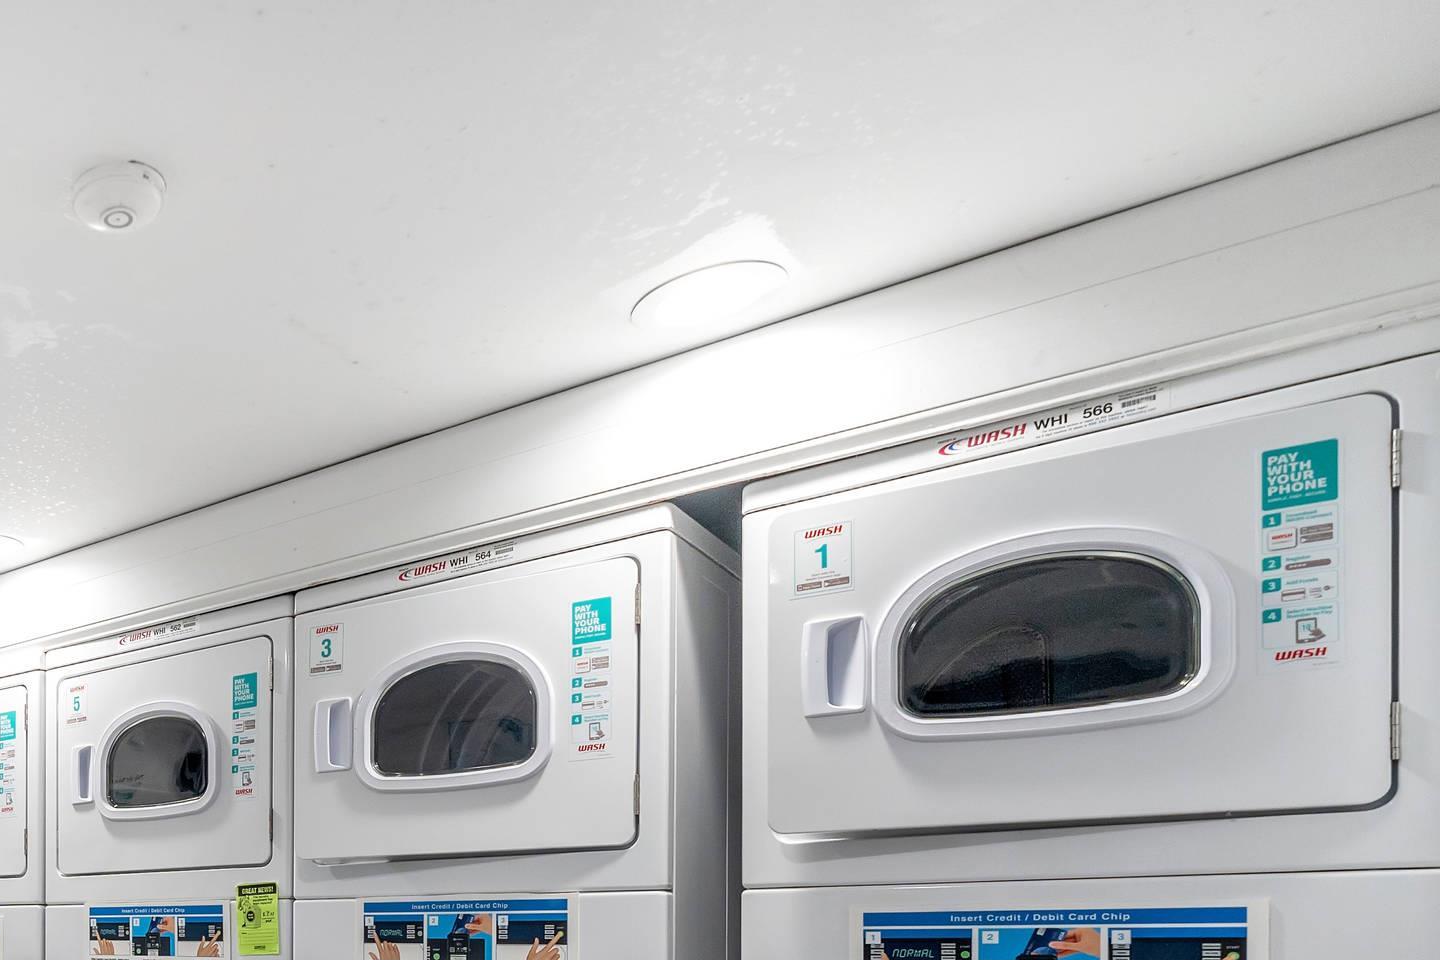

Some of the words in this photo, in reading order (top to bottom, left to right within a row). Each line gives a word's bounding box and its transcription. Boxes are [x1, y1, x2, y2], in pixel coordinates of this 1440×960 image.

[967, 423, 1027, 448] WASH
[1034, 413, 1068, 431] WHI
[1083, 403, 1113, 419] 566
[1267, 452, 1298, 466] PAY
[1267, 459, 1312, 476] WITH
[1267, 469, 1314, 486] YOUR
[1267, 477, 1328, 497] PHONE
[1268, 516, 1276, 525] 1
[804, 525, 843, 539] WASH
[815, 543, 828, 569] 1
[413, 561, 447, 577] WASH
[450, 555, 469, 567] WHI
[475, 550, 492, 561] 564
[1268, 560, 1277, 568] 2
[1268, 581, 1276, 590] 3
[575, 604, 591, 613] PAY
[575, 610, 598, 620] WITH
[1267, 612, 1277, 620] 4
[575, 618, 599, 628] YOUR
[575, 623, 606, 635] PHONE
[129, 630, 152, 642] WASH
[153, 627, 166, 636] WHI
[170, 623, 182, 633] 562
[315, 625, 339, 635] WASH
[321, 638, 332, 658] 3
[1275, 646, 1328, 661] WASH
[72, 695, 81, 712] 5
[578, 743, 606, 752] WASH
[235, 788, 253, 796] WASH
[492, 902, 509, 911] Chip
[950, 914, 982, 922] Insert
[986, 913, 1021, 922] Credit
[1033, 913, 1065, 922] Debit
[1068, 912, 1097, 922] Card
[1101, 911, 1131, 923] Chip
[1117, 933, 1125, 941] 3
